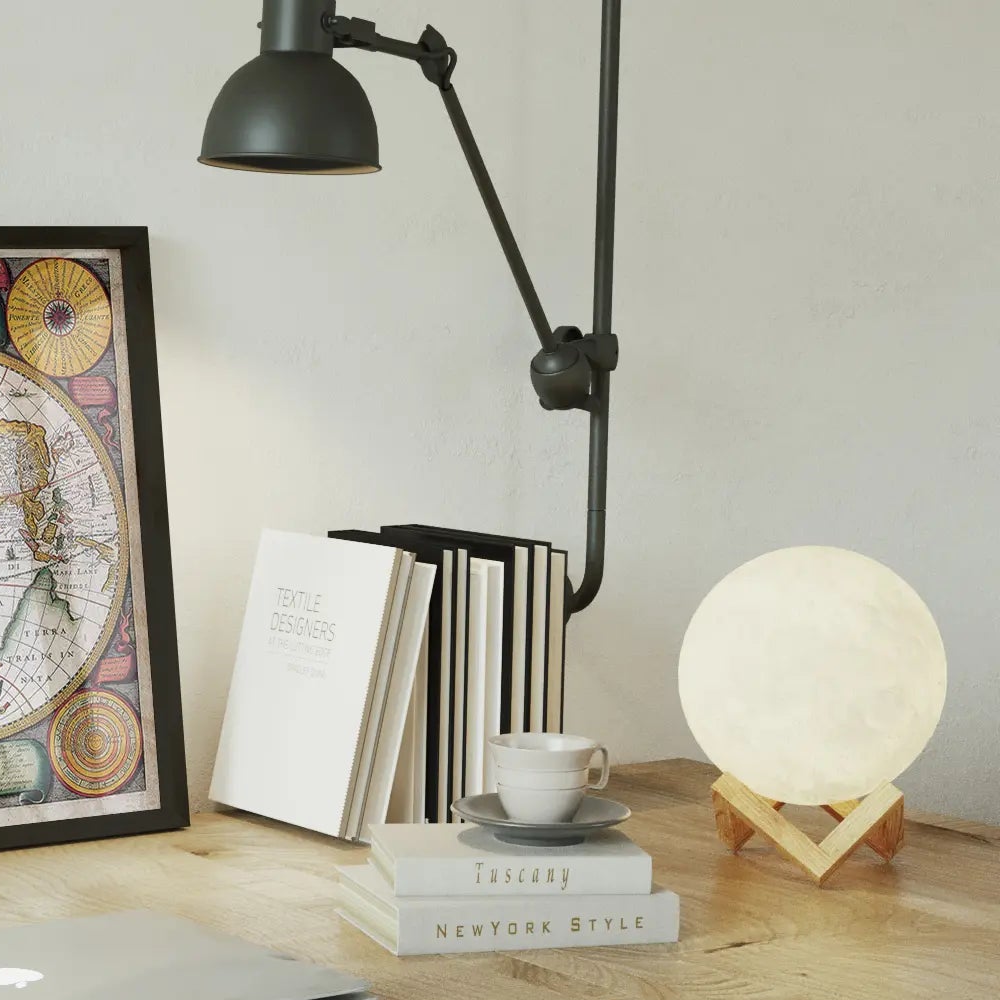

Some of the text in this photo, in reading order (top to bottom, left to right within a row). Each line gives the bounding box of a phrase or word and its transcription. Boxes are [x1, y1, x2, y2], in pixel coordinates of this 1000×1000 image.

[277, 587, 322, 613] TEXTILE
[270, 612, 336, 641] DESIGNERS
[475, 862, 570, 890] Tuscany
